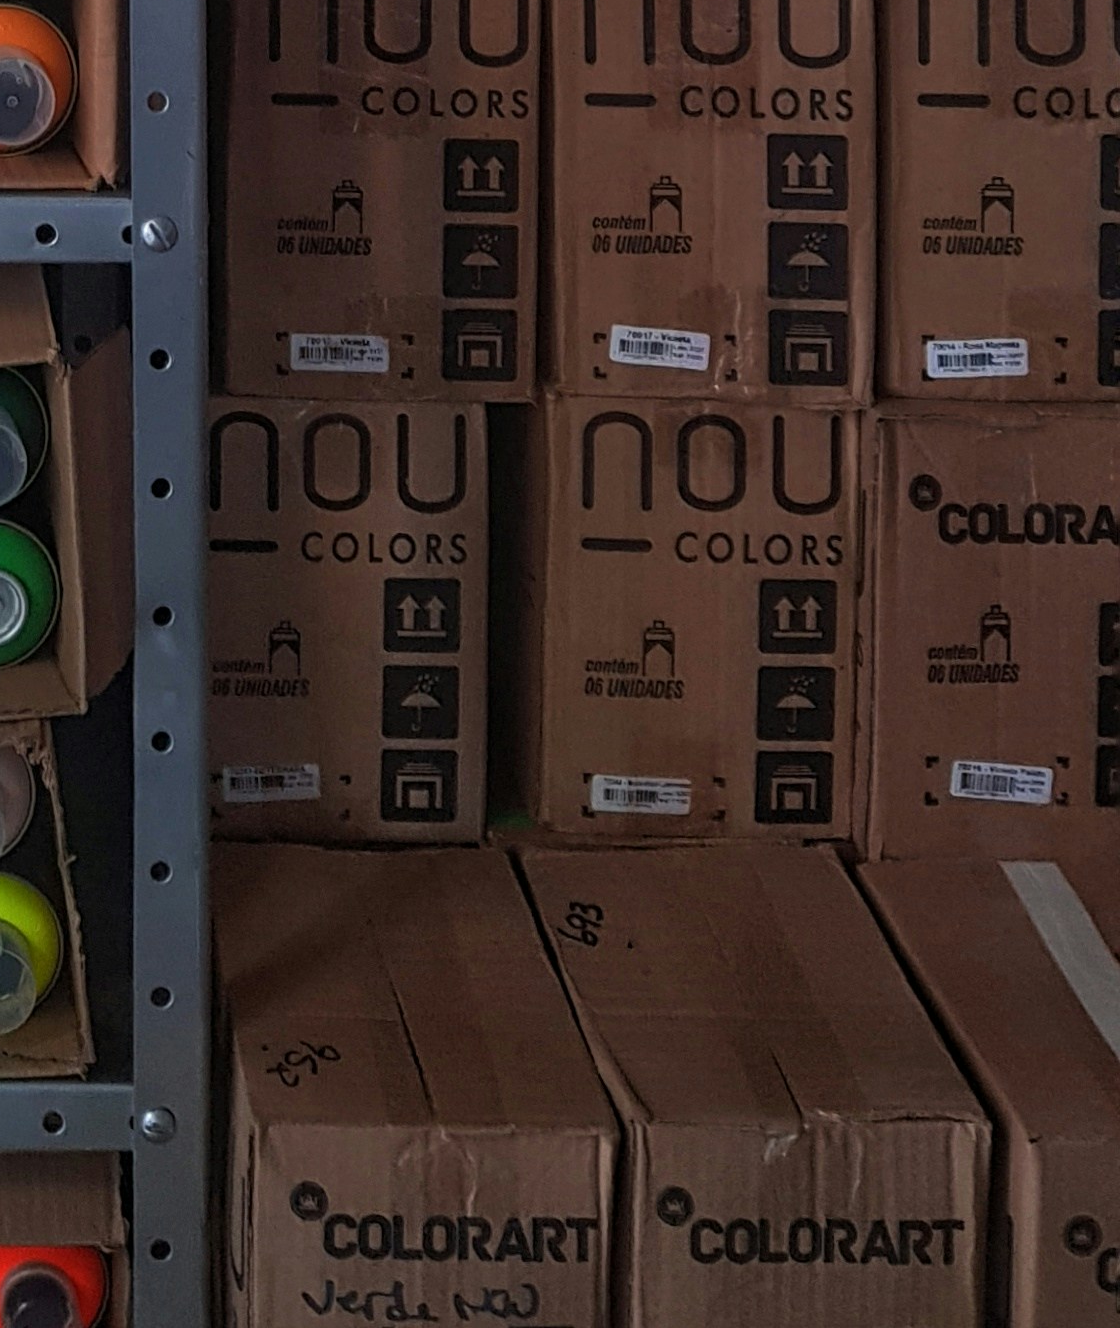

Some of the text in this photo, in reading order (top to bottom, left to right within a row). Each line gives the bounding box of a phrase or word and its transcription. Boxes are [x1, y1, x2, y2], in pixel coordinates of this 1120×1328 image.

[361, 86, 530, 119] COLORS
[679, 85, 854, 122] COLORS
[592, 215, 646, 230] contém
[922, 216, 976, 231] contém
[298, 237, 372, 256] UNIDADES
[592, 234, 692, 254] 06 UNIDADES
[922, 235, 1024, 256] 06 UNIDADES
[301, 531, 467, 565] COLORS
[674, 531, 843, 566] COLORS
[585, 659, 639, 675] contém
[948, 662, 1020, 683] UNIDADES
[234, 678, 310, 697] UNIDADES
[584, 676, 685, 699] 06 UNIDADES
[557, 901, 604, 947] 693
[322, 1212, 598, 1263] COLORART
[689, 1217, 965, 1266] COLORART
